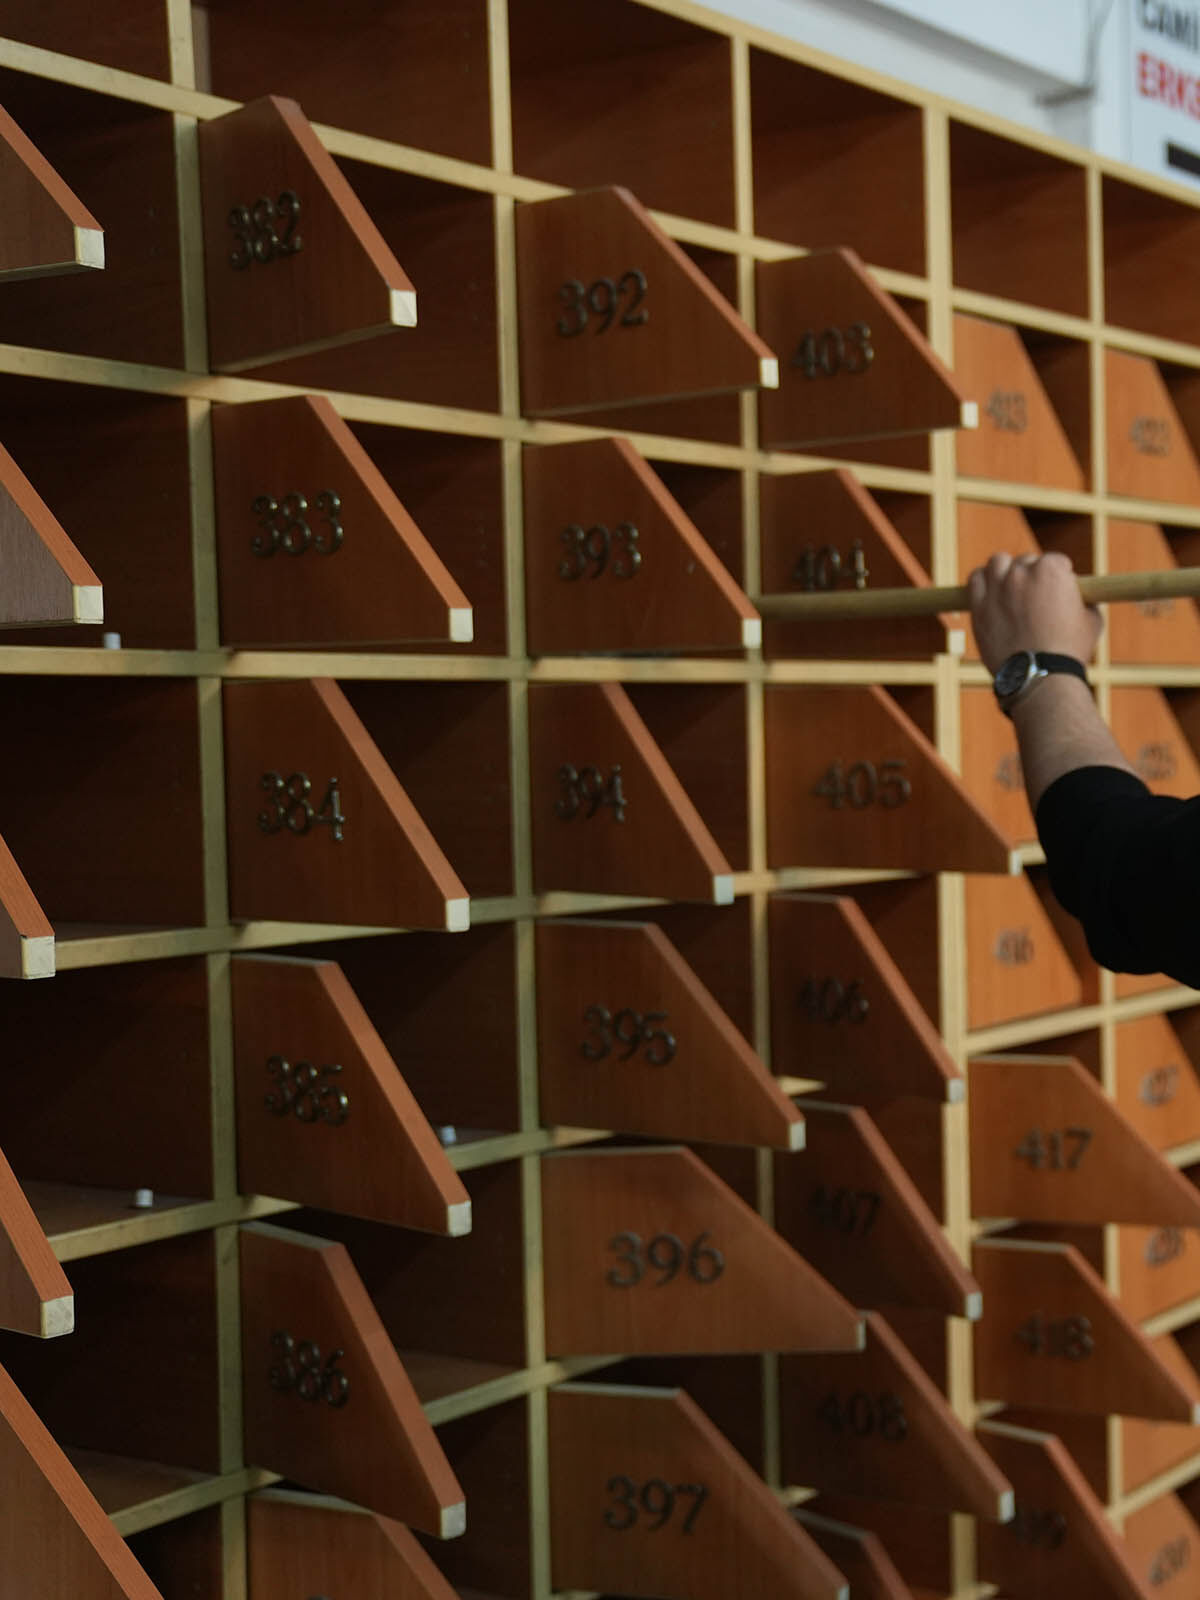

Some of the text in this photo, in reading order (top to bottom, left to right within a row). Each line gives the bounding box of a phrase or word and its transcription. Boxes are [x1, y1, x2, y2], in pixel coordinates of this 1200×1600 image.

[228, 191, 304, 270] 382
[556, 269, 649, 339] 392
[791, 321, 874, 380] 403
[250, 489, 344, 557] 383
[557, 523, 641, 582] 393
[792, 539, 869, 590] 404
[258, 770, 345, 842] 384
[553, 763, 628, 823] 394
[811, 758, 912, 810] 405
[797, 976, 870, 1026] 406
[580, 1003, 677, 1067] 395
[264, 1056, 348, 1124] 385
[1013, 1127, 1092, 1173] 417
[807, 1182, 881, 1238] 407
[605, 1229, 725, 1290] 396
[1012, 1312, 1095, 1362] 418
[268, 1330, 348, 1409] 386
[819, 1388, 908, 1442] 408
[601, 1474, 708, 1538] 397
